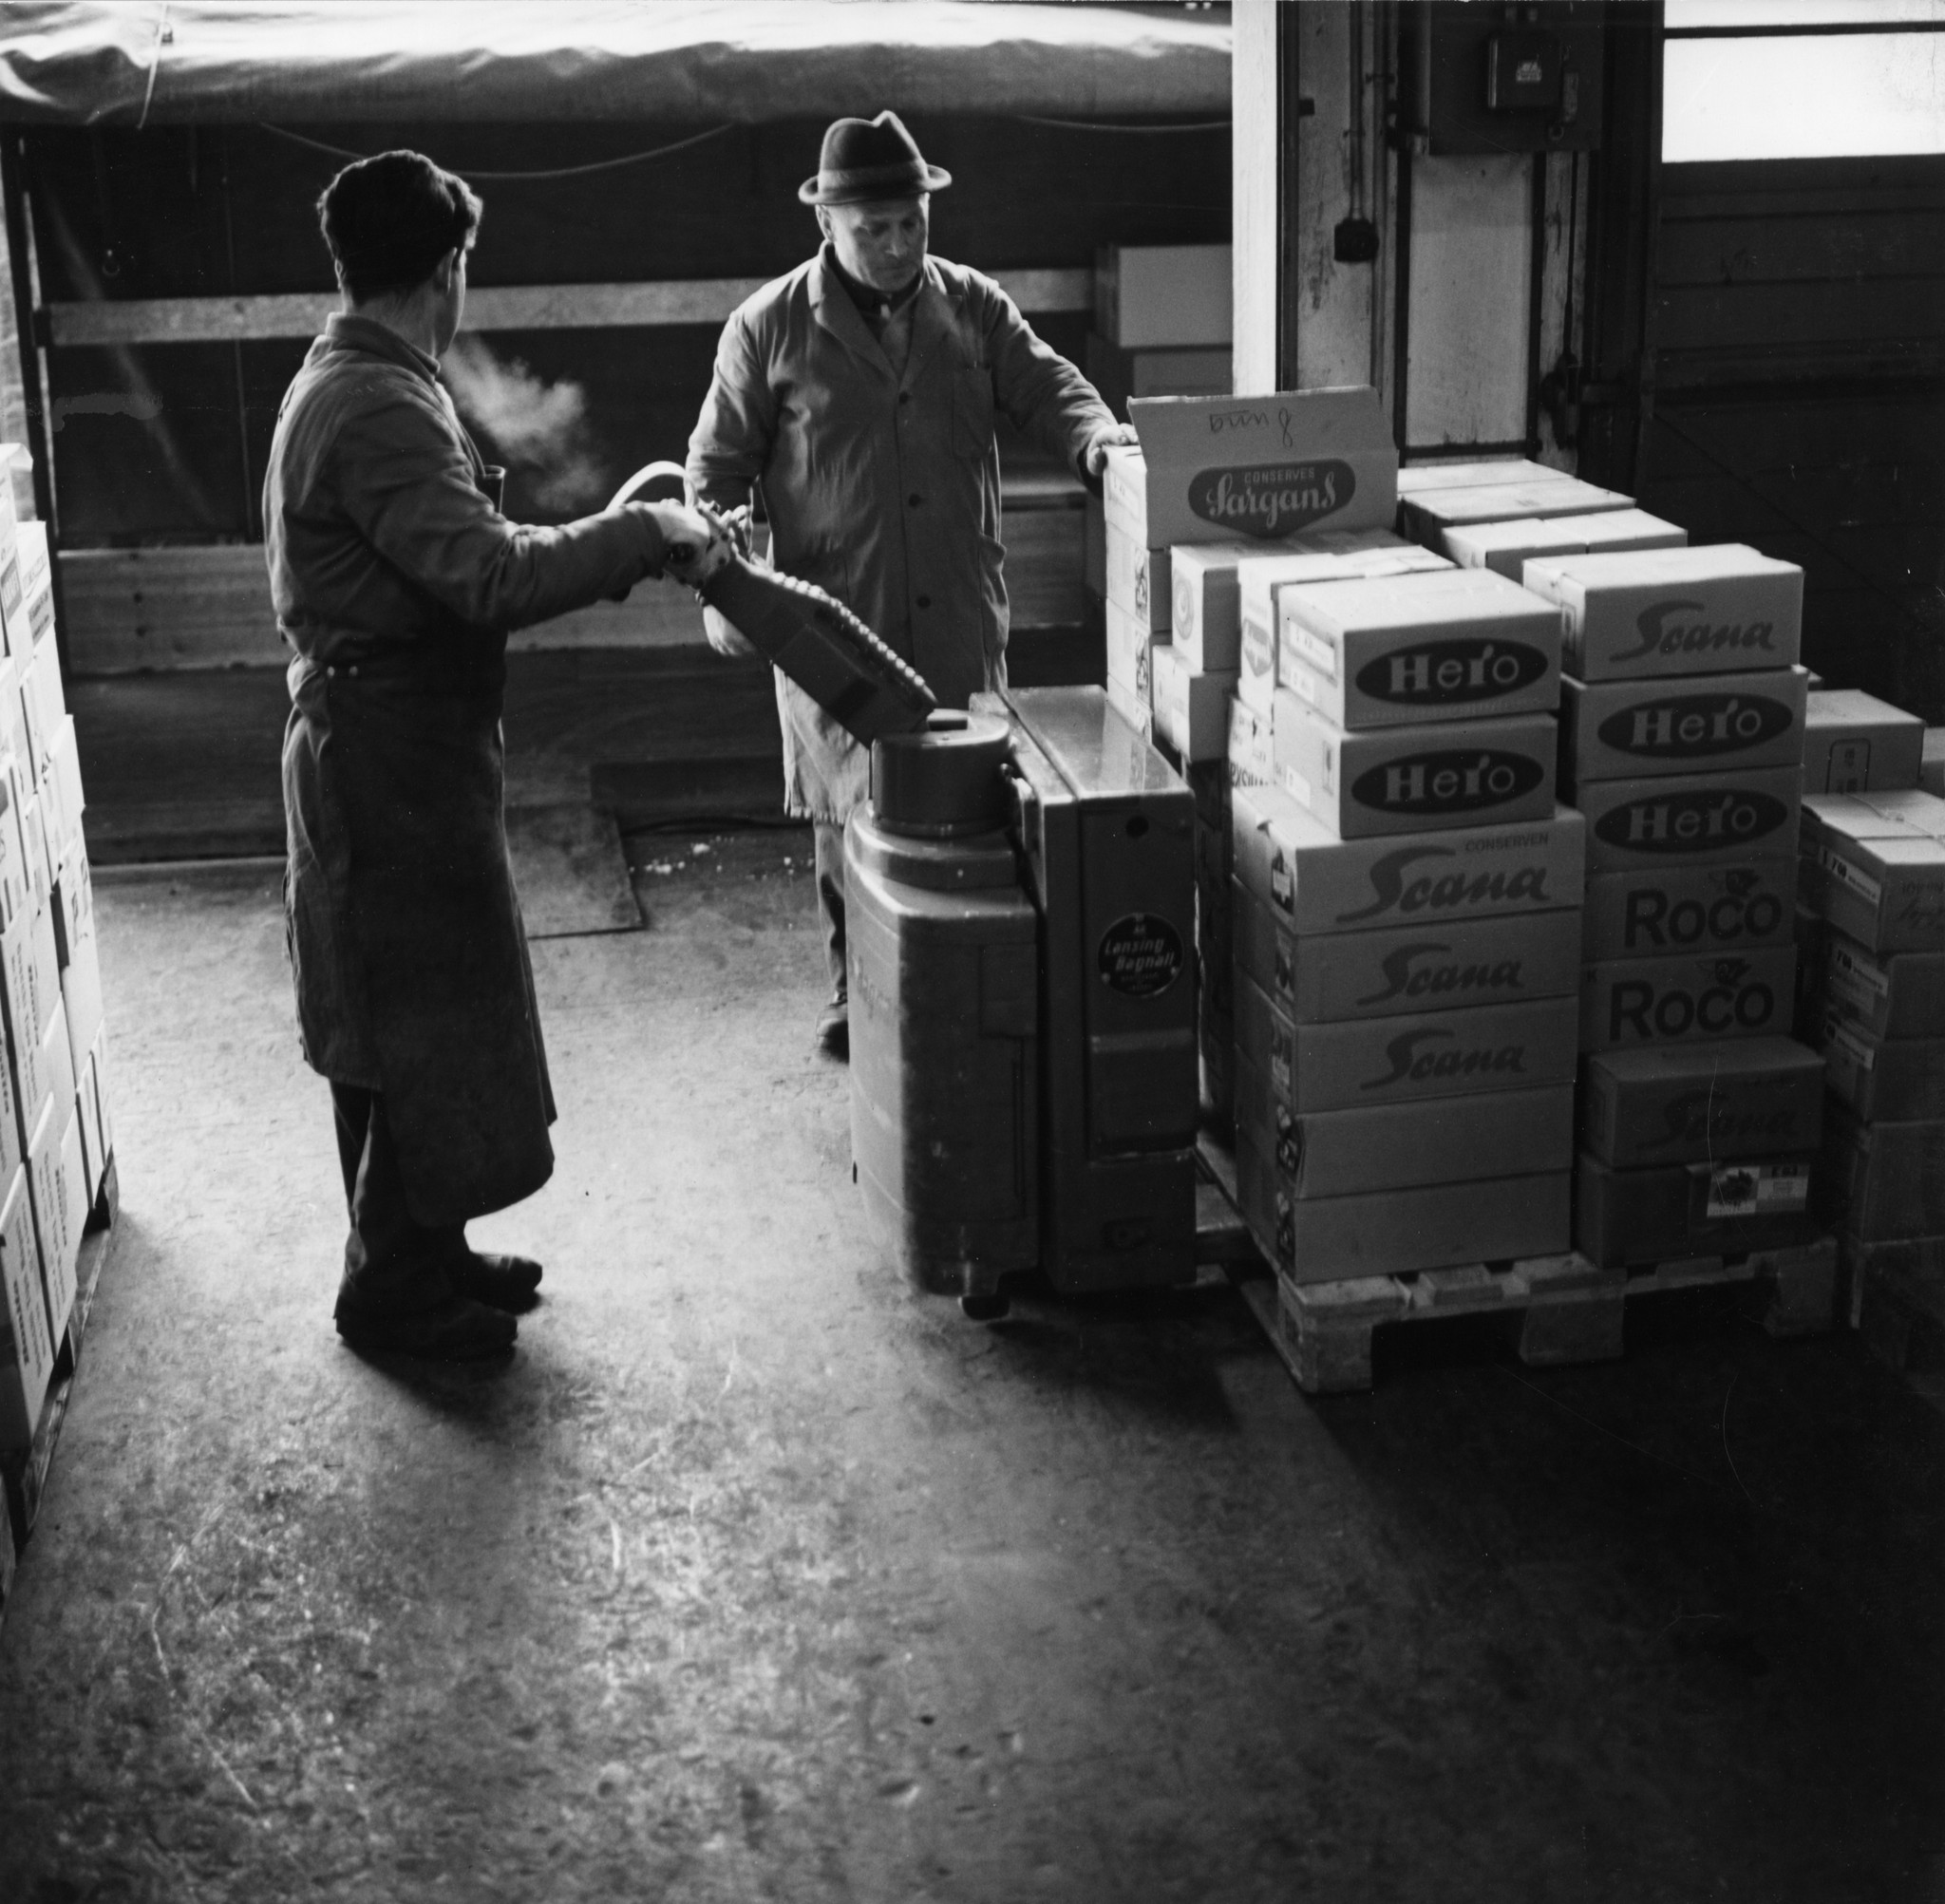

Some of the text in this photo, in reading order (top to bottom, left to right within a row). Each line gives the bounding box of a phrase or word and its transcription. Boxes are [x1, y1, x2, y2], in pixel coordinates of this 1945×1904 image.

[1206, 471, 1336, 529] Sargans
[1610, 600, 1776, 662] Scana
[1388, 644, 1520, 694] Hero
[1630, 698, 1763, 746] Hero
[1385, 755, 1516, 805] Hero
[1465, 832, 1550, 853] CONSERVEN
[1626, 796, 1758, 842] Hero
[1336, 845, 1550, 923] Scana
[1356, 943, 1524, 1006] Scana
[1360, 1028, 1526, 1089] Scana
